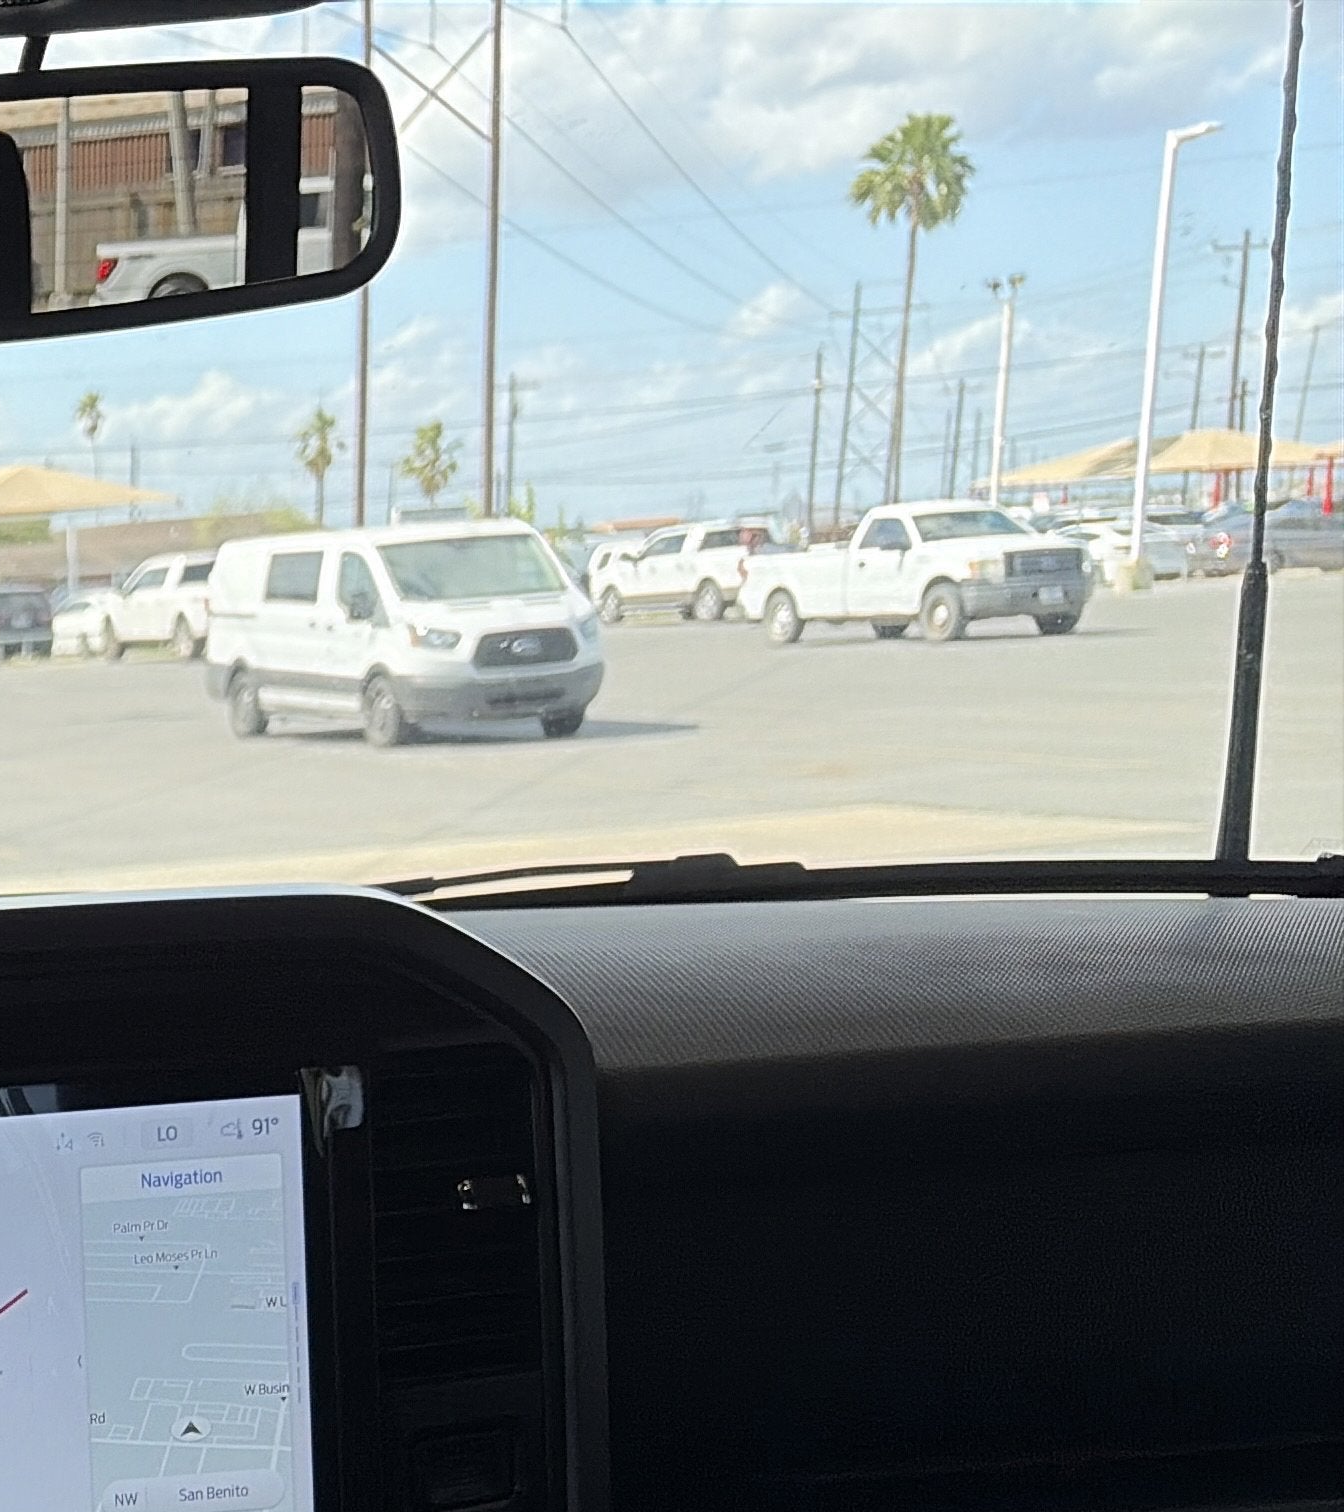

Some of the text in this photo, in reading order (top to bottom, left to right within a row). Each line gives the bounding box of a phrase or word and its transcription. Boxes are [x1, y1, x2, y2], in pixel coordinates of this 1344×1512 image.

[157, 1126, 177, 1142] LO
[141, 1169, 223, 1189] Navigation
[113, 1222, 142, 1233] Palm
[156, 1220, 169, 1230] Dr
[134, 1254, 153, 1265] Leo
[155, 1251, 189, 1263] Moses
[205, 1250, 217, 1260] Ln
[244, 1382, 290, 1396] W Busin
[90, 1412, 105, 1424] Rd
[114, 1492, 138, 1506] NW
[179, 1484, 249, 1502] San Benito
